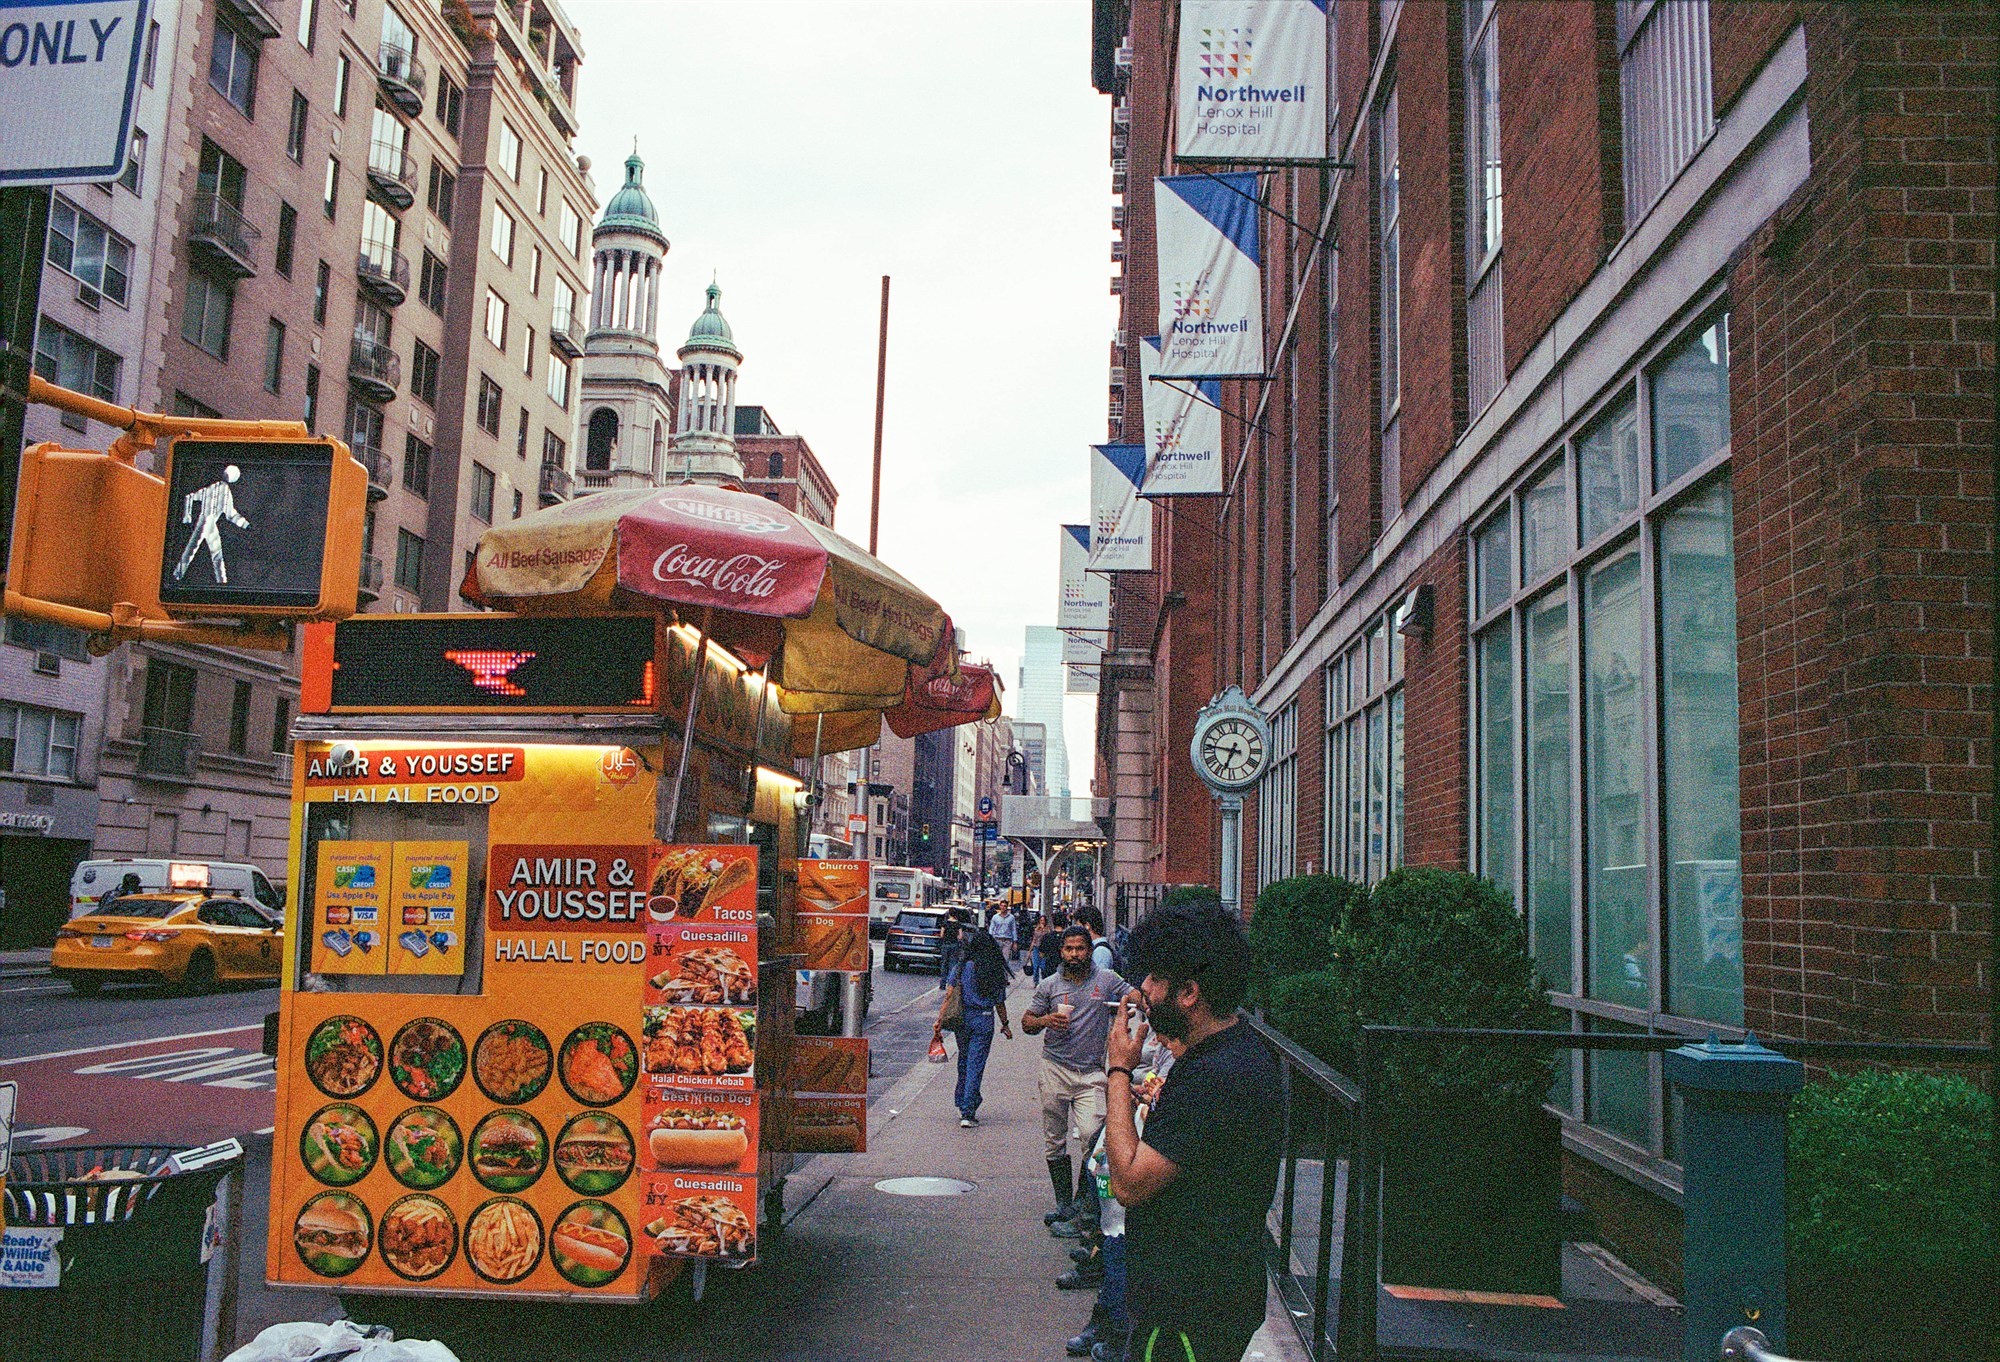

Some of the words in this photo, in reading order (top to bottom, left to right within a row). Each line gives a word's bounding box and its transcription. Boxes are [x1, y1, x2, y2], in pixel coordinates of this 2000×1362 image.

[0, 17, 121, 68] ONLY
[1198, 85, 1305, 102] Northwell
[1197, 106, 1243, 118] Lenox
[1249, 105, 1273, 118] Hill
[1197, 122, 1260, 136] Hospital
[1172, 319, 1248, 334] Northwell
[1172, 335, 1205, 346] Lenox
[1208, 335, 1226, 345] Hill
[1172, 348, 1218, 360] Hospital
[677, 500, 760, 524] NIKAS
[1097, 536, 1143, 544] Northwell
[486, 553, 508, 569] All
[511, 550, 540, 568] Beef
[543, 546, 605, 567] Sausages
[652, 544, 787, 598] Coca-Cola
[1064, 600, 1103, 608] Northwell
[379, 756, 397, 776] &
[405, 753, 514, 775] YOUSSEF
[604, 752, 636, 772] حلال
[333, 786, 414, 803] HALAL
[426, 785, 500, 804] FOOD
[0, 812, 53, 834] armacy
[509, 858, 597, 887] AMIR
[607, 858, 635, 887] &
[818, 862, 859, 870] Churros
[342, 892, 363, 900] Apple
[366, 892, 378, 901] Pay
[418, 892, 440, 900] Apple
[442, 892, 456, 901] Pay
[495, 889, 647, 920] YOUSSEF
[713, 906, 753, 921] Tacos
[816, 917, 834, 926] Dog
[681, 930, 748, 942] Quesadilla
[496, 939, 574, 962] HALAL
[581, 940, 647, 962] FOOD
[652, 1074, 674, 1084] Halal
[678, 1075, 713, 1085] Chicken
[716, 1076, 744, 1086] Kebab
[704, 1093, 725, 1103] Hot
[728, 1094, 752, 1106] Dog
[674, 1178, 743, 1192] Quesadilla
[3, 1234, 43, 1249] Ready
[5, 1248, 51, 1262] Willing
[3, 1260, 13, 1271] &
[14, 1260, 45, 1272] Able
